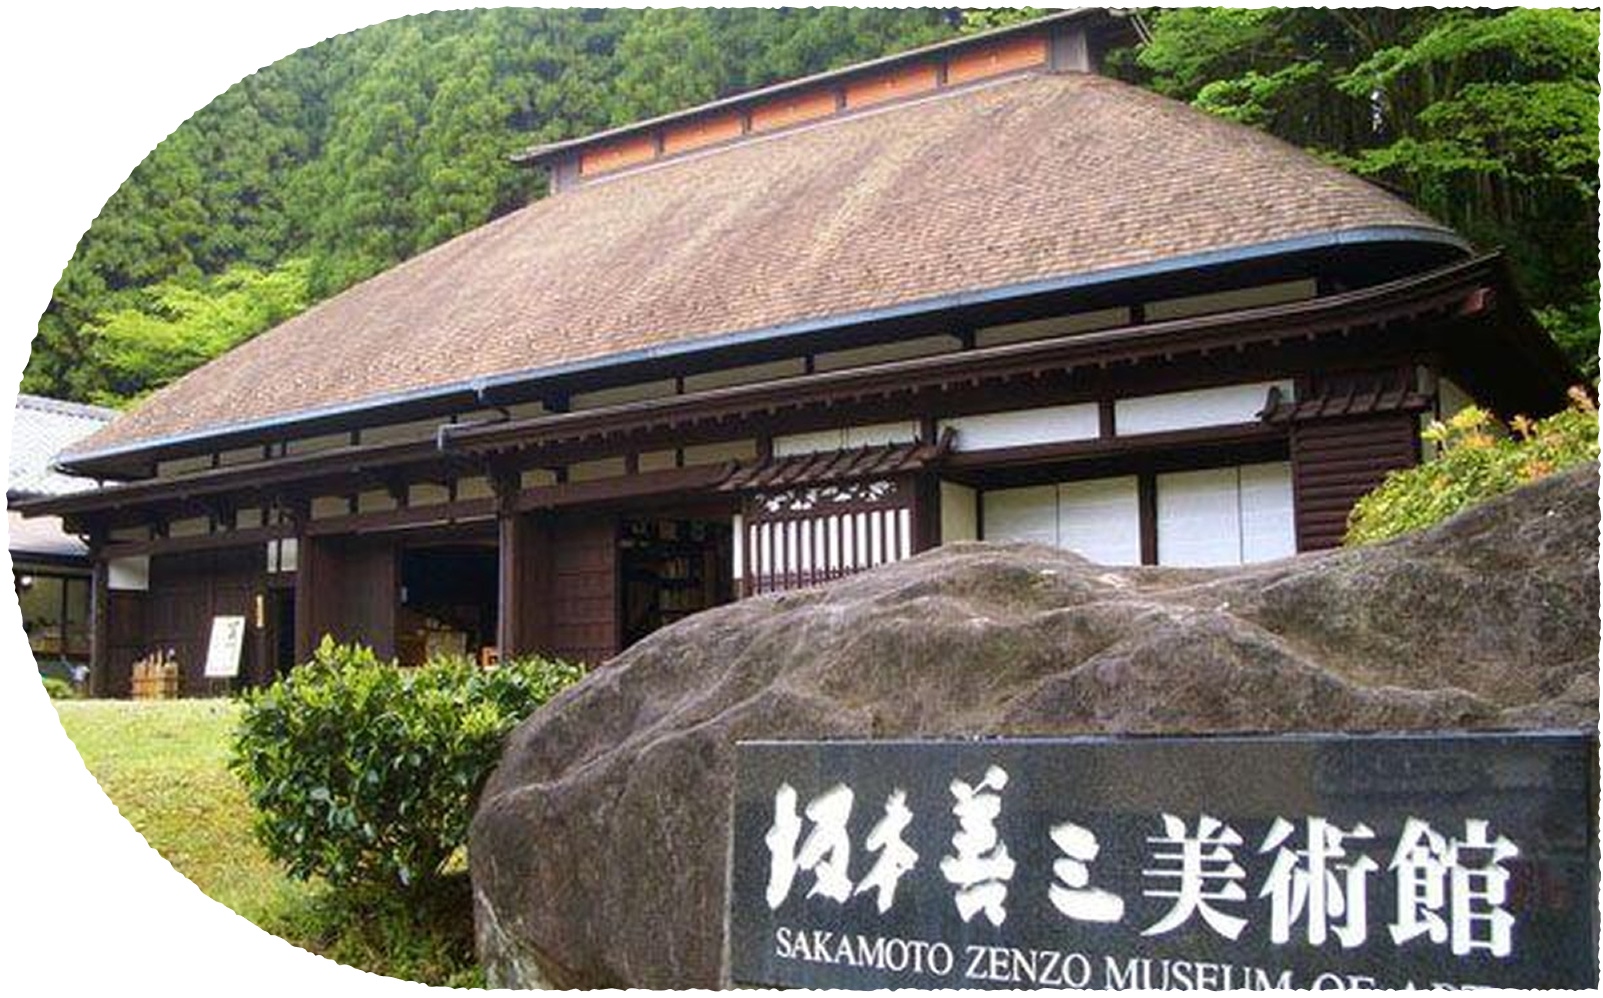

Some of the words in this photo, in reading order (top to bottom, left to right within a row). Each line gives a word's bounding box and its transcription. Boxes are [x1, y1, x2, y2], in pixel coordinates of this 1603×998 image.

[765, 765, 1518, 956] 坂本善三美術館
[776, 926, 953, 975] SAKAMOTO
[965, 945, 1091, 988] ZENZO
[1104, 955, 1293, 991] MUSEUM
